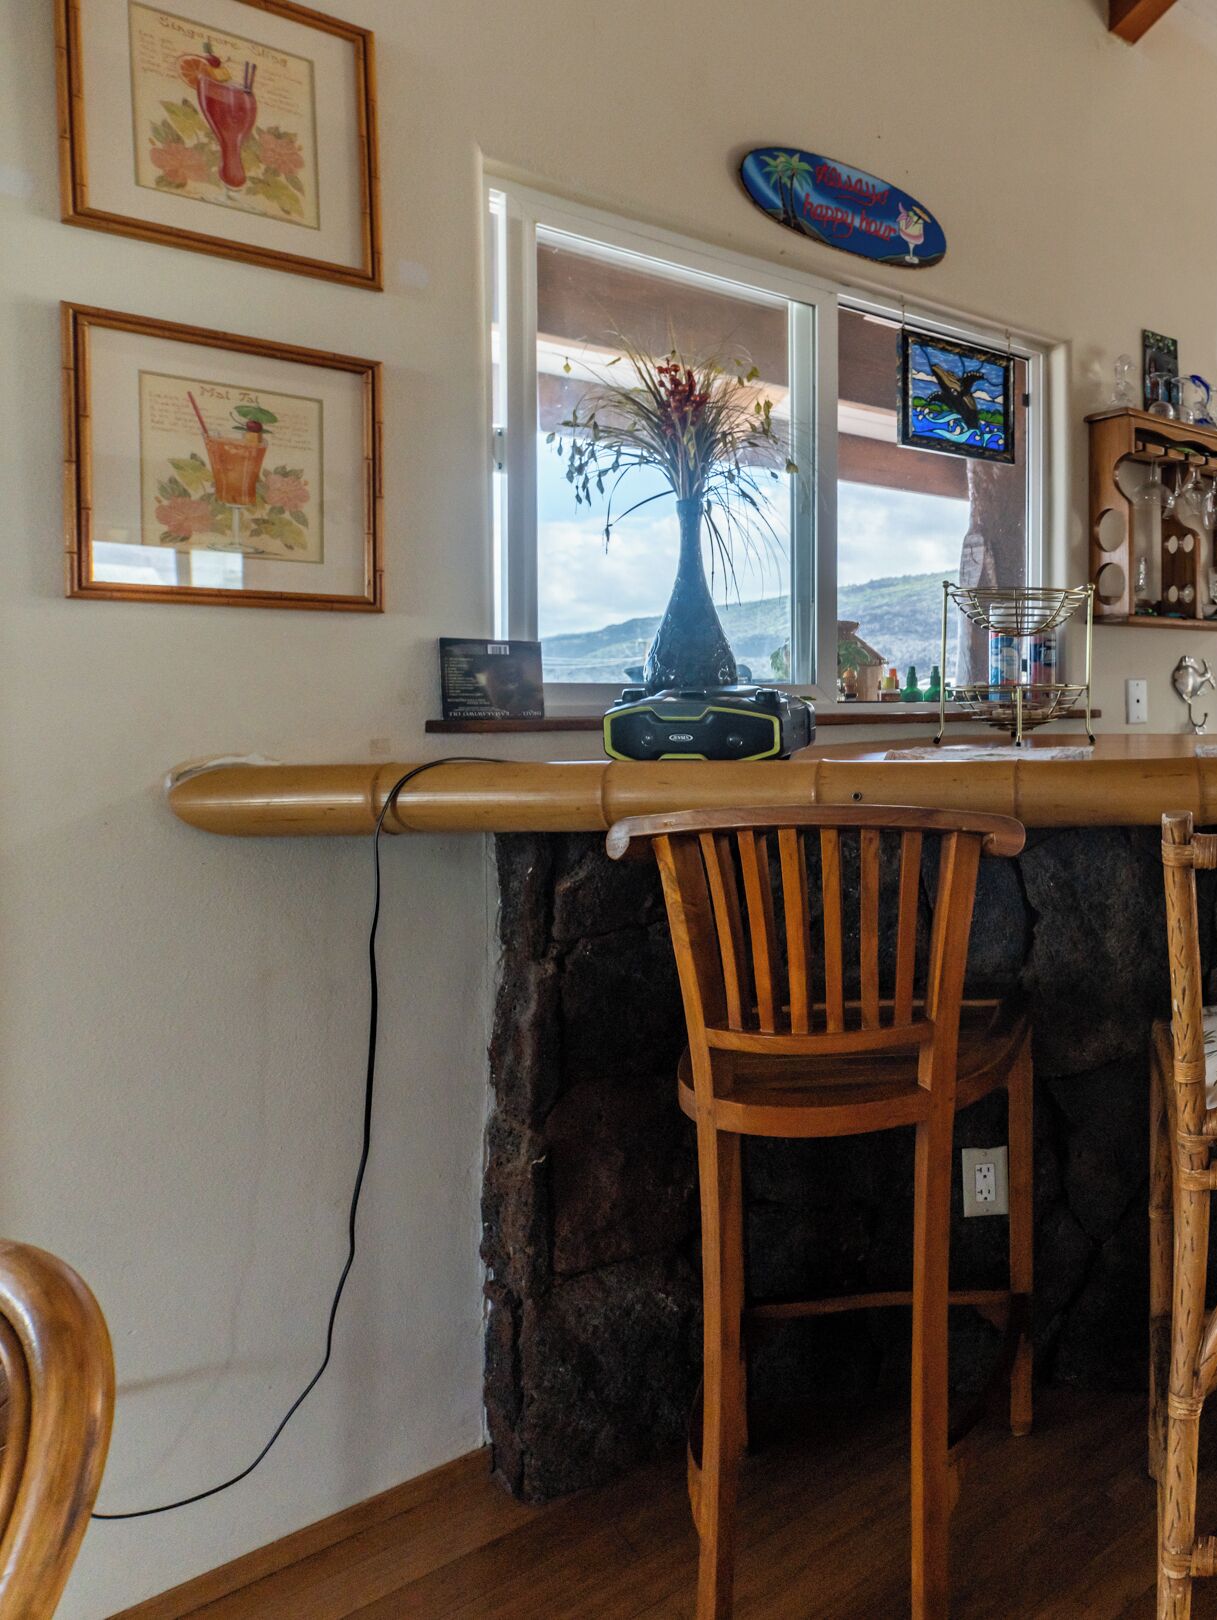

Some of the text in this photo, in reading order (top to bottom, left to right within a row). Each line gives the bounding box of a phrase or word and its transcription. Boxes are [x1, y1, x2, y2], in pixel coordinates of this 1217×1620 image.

[803, 192, 897, 241] happy hour
[200, 386, 231, 401] Mai
